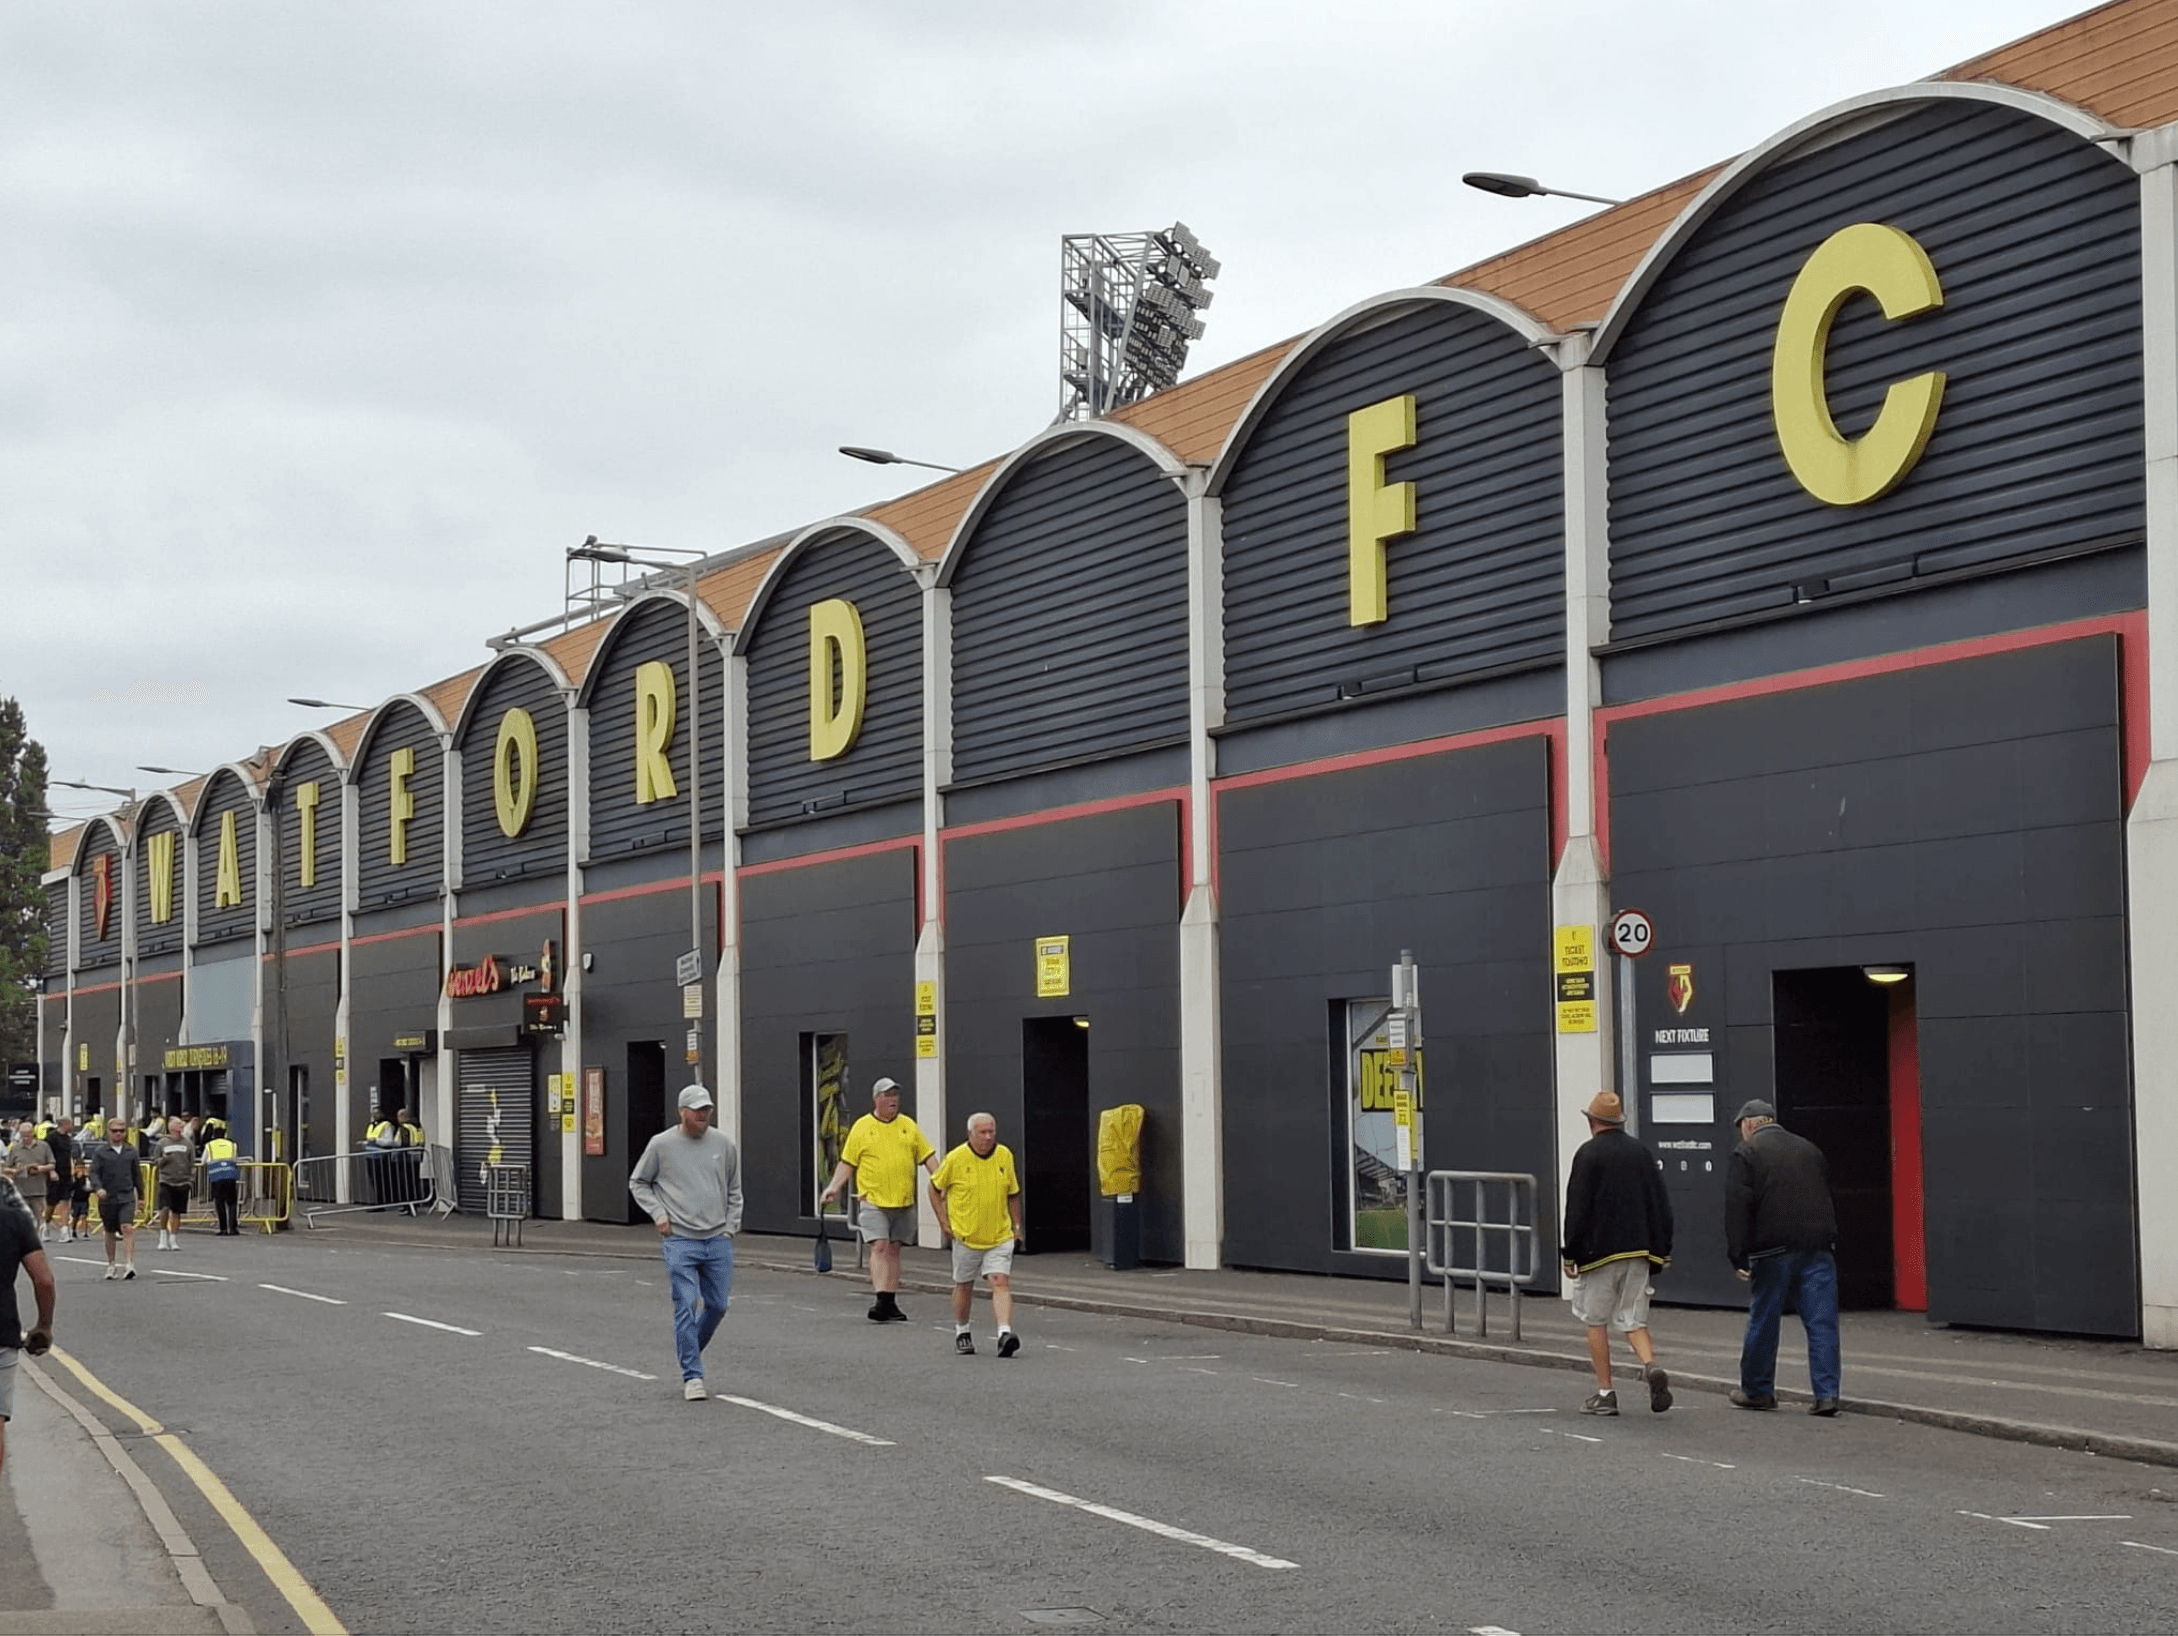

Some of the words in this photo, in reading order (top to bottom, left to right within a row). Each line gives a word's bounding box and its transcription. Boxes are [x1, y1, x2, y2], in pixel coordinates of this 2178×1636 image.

[1349, 222, 1946, 627] FC
[1618, 923, 1648, 942] 20
[1655, 1029, 1677, 1044] NEXT
[1677, 1027, 1710, 1043] FIXTURE
